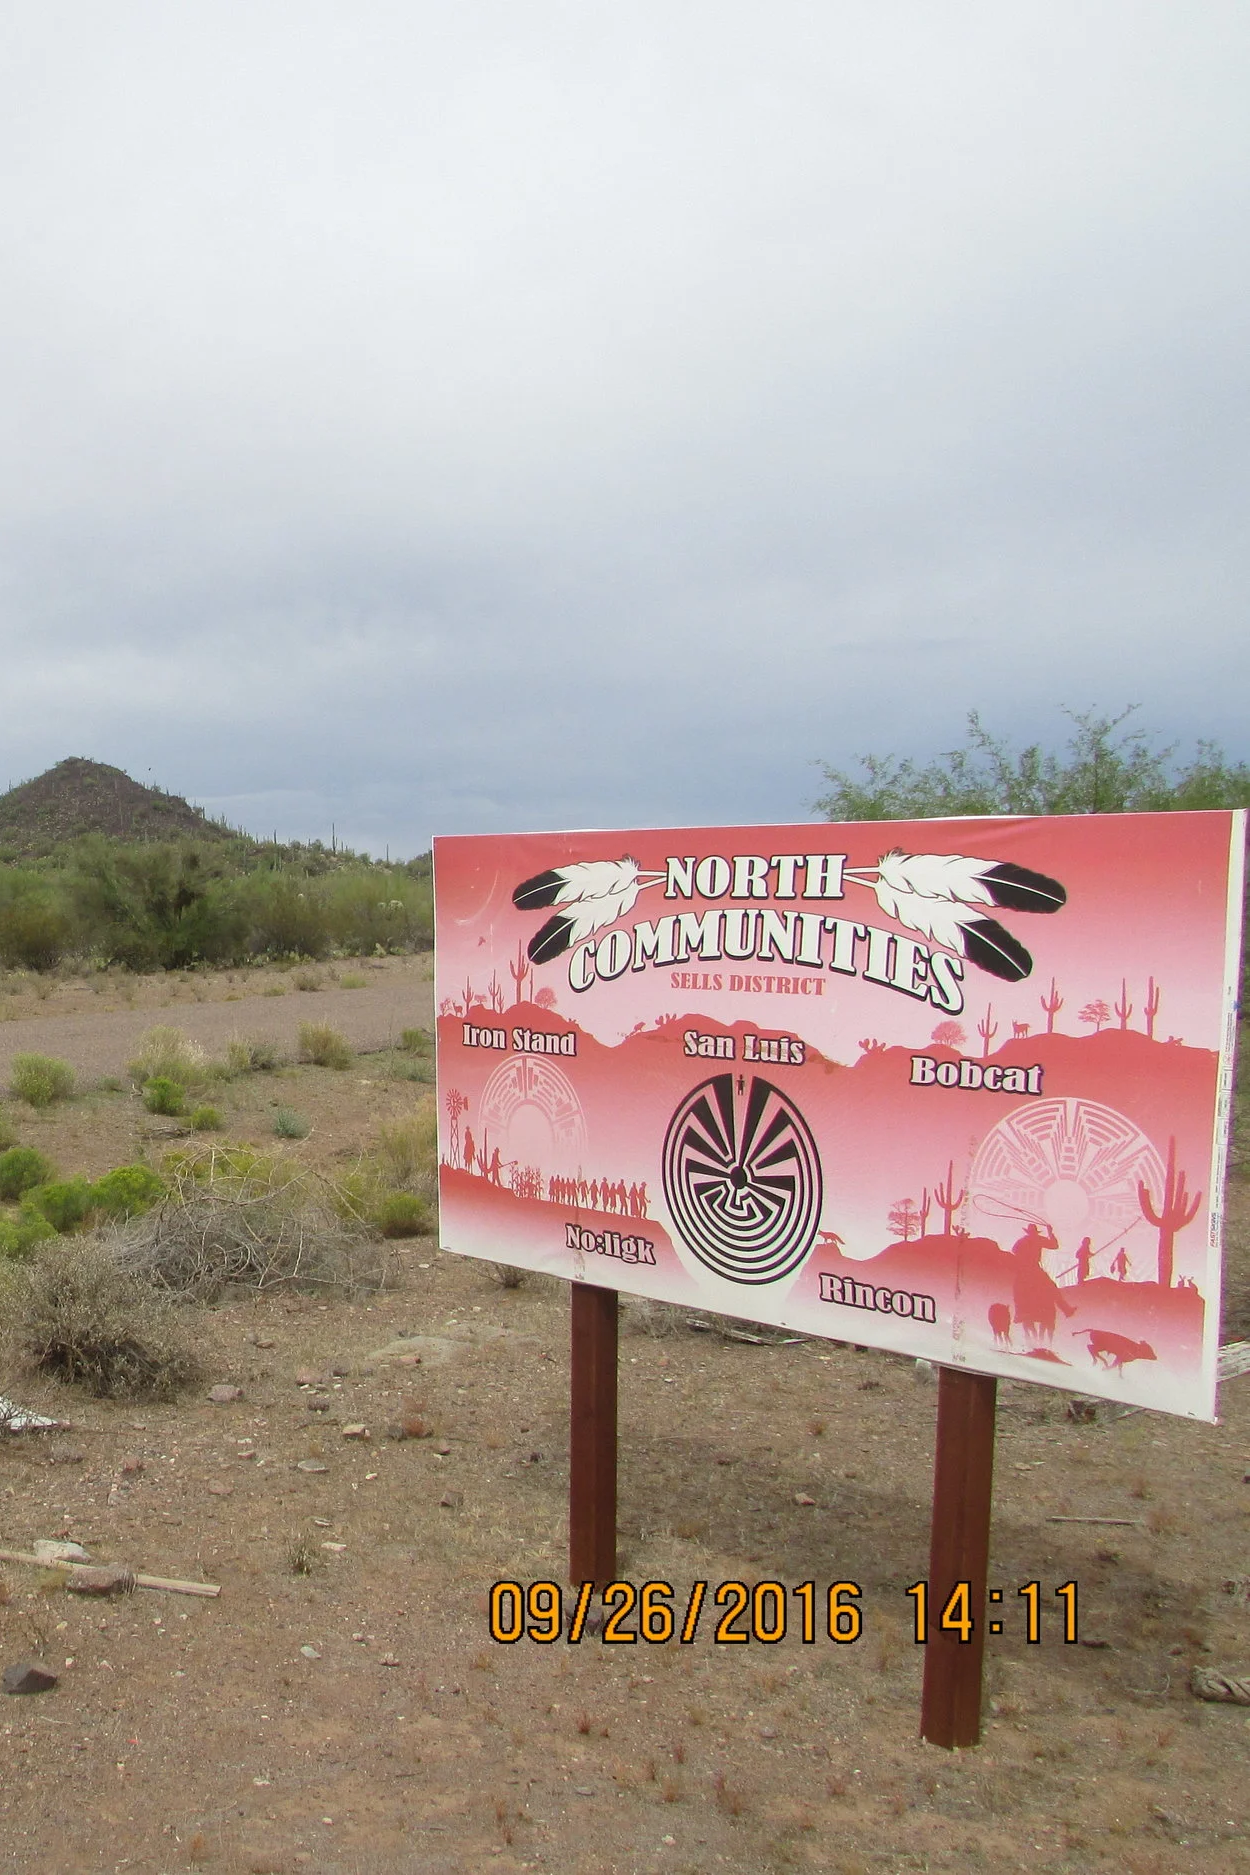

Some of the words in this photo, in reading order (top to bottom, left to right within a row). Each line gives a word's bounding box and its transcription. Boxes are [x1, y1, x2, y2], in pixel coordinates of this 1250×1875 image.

[664, 854, 847, 899] NORTH
[568, 908, 964, 1015] COMMUNITIES
[670, 972, 723, 992] SELLS
[729, 975, 826, 996] DISTRICT
[462, 1023, 507, 1049] Iron
[512, 1027, 577, 1056] Stand
[683, 1030, 737, 1059] San
[742, 1034, 807, 1065] Luis
[910, 1055, 1044, 1096] Bobcat
[565, 1223, 657, 1265] No:ligk
[817, 1272, 937, 1323] Rincon
